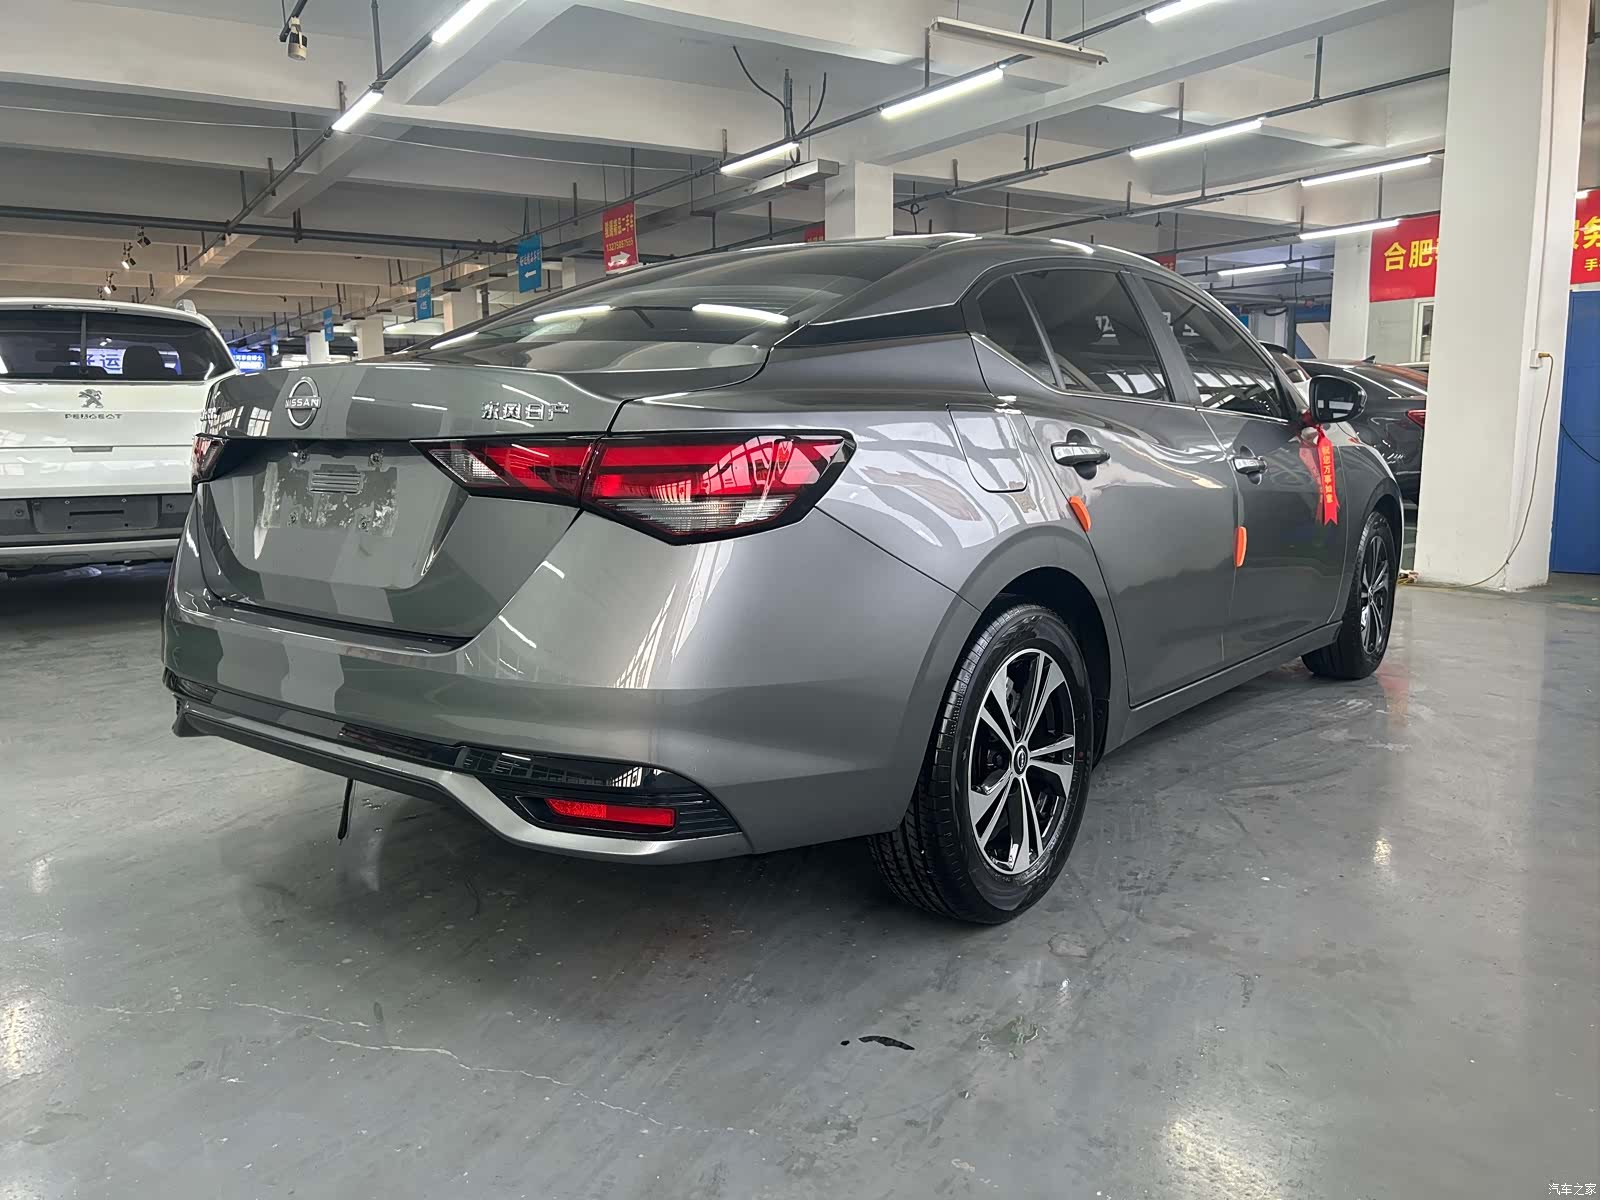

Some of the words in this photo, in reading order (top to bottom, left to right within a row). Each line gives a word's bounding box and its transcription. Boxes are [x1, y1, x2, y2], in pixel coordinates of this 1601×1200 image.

[1384, 238, 1440, 272] 合肥
[285, 398, 320, 407] NISSAN
[481, 401, 569, 421] 东风日产
